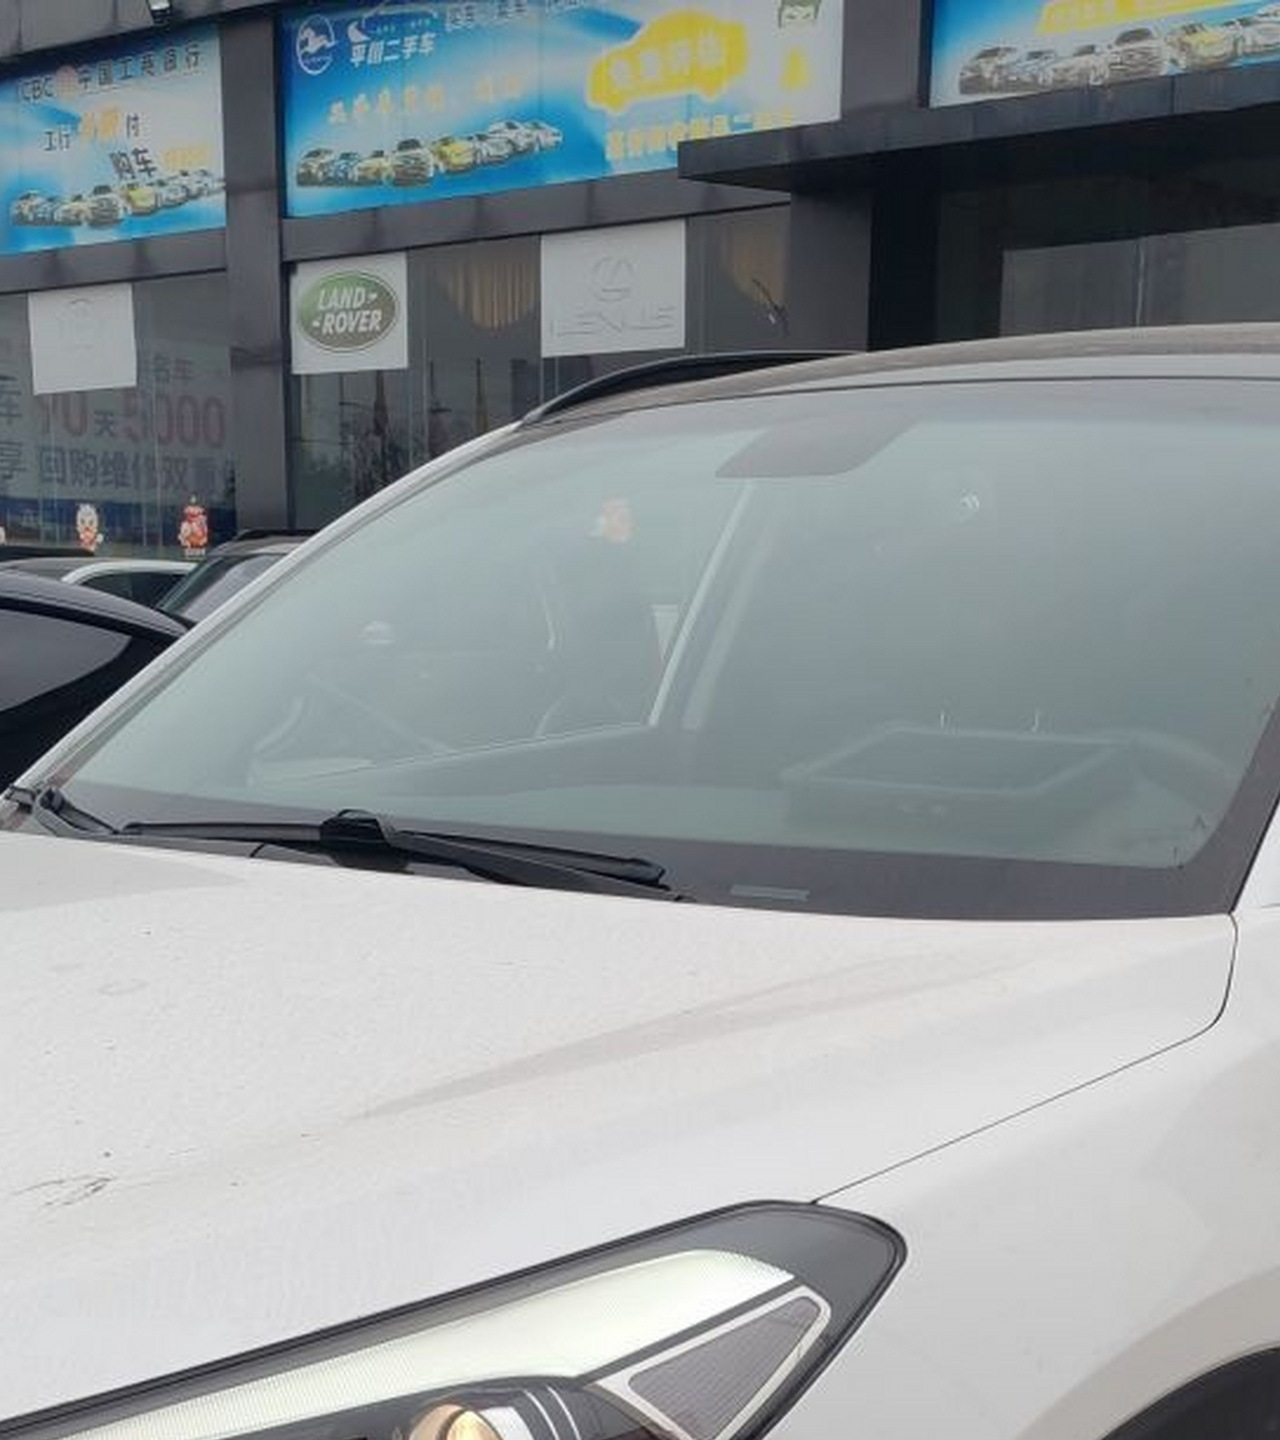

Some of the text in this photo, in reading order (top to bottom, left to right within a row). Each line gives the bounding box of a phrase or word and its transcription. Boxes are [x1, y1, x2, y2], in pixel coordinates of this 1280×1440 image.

[77, 43, 201, 90] 中国工商银行
[322, 308, 383, 336] ROVER
